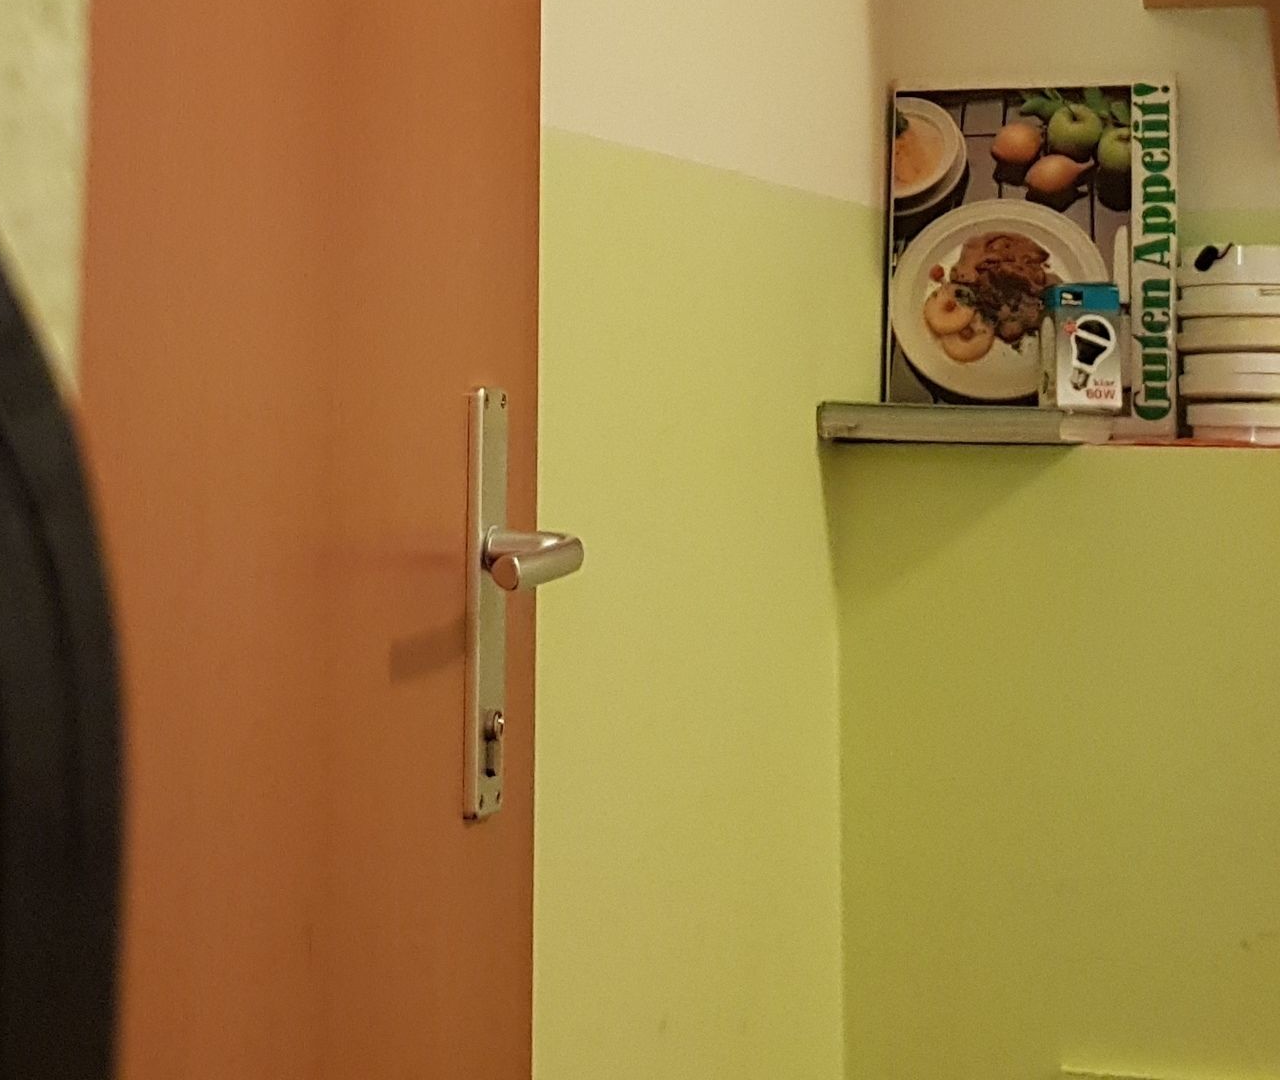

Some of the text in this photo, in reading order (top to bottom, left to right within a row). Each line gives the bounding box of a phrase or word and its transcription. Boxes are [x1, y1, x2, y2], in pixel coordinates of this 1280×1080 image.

[1132, 81, 1177, 421] Guten Appetit!
[1086, 388, 1116, 400] 60W
